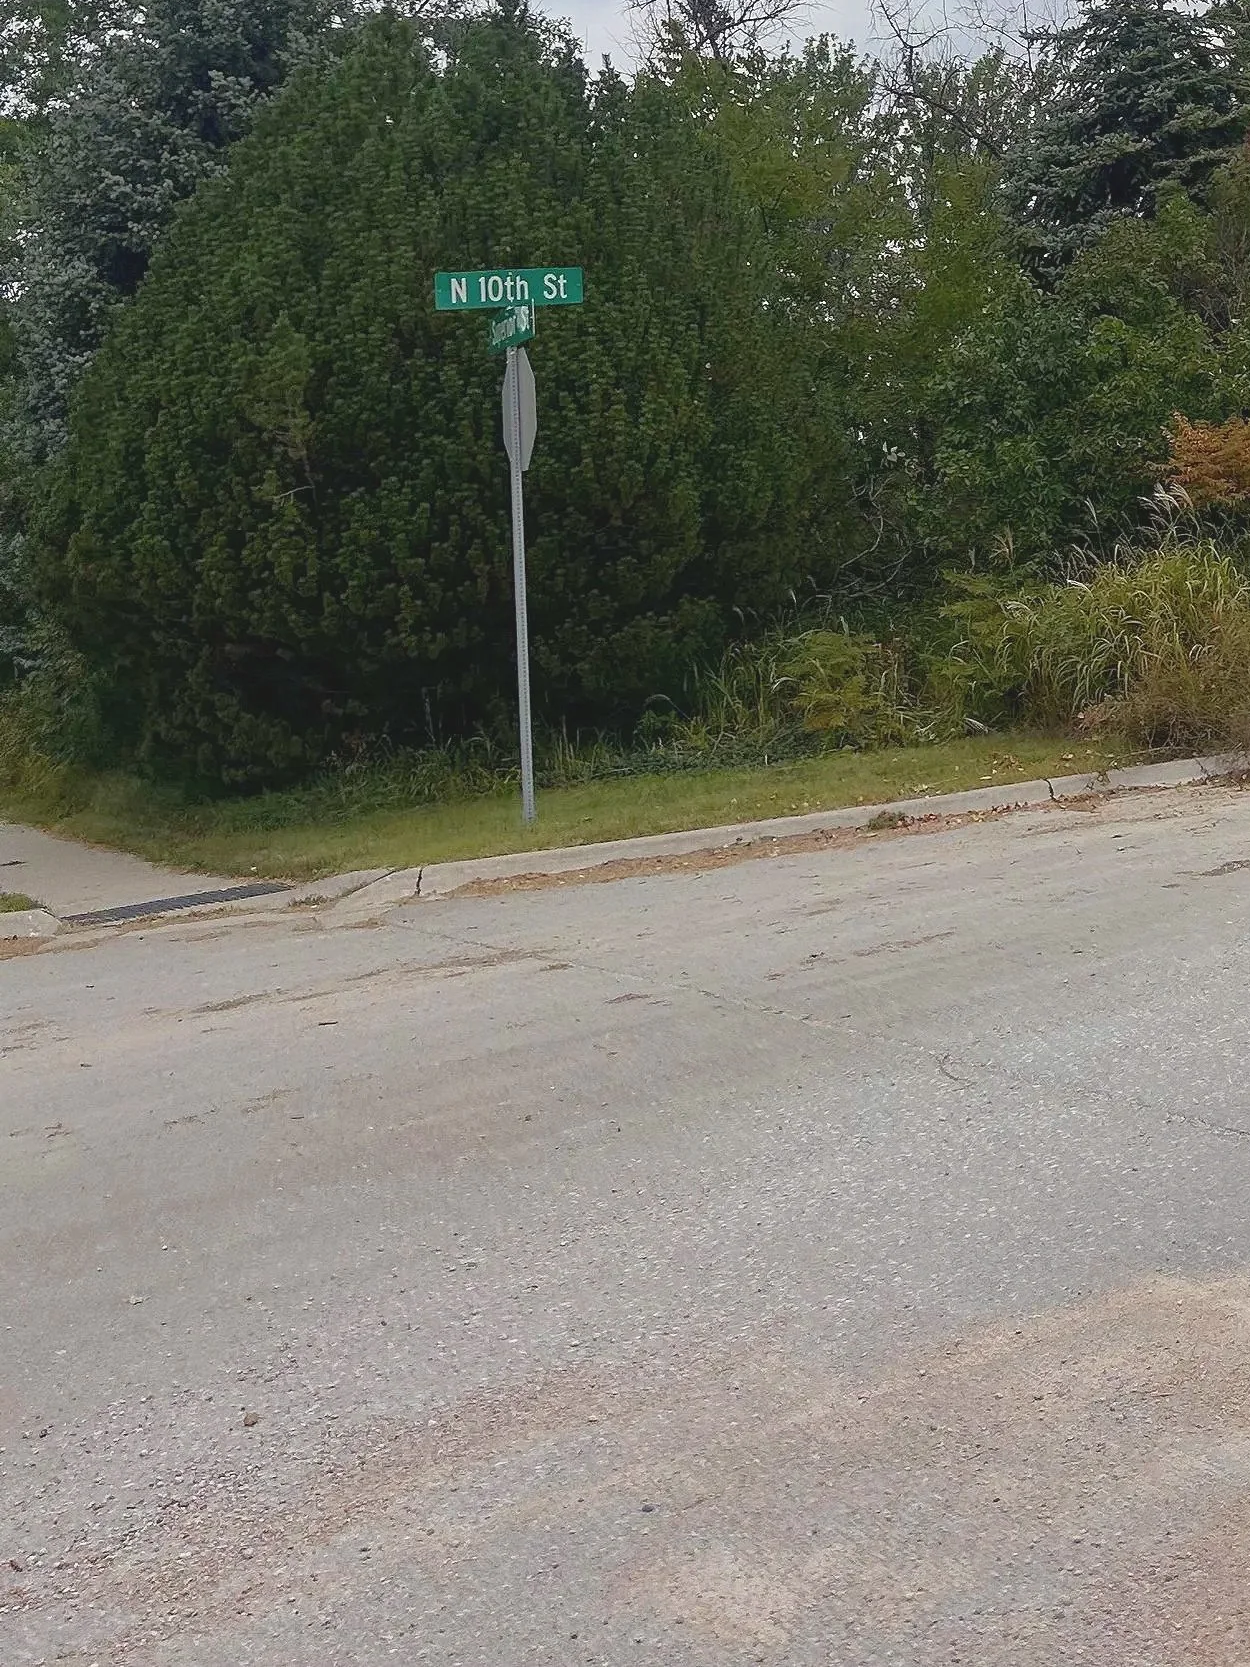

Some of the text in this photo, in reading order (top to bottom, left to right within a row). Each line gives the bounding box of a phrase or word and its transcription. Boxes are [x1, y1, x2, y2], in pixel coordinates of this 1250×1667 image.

[450, 273, 568, 304] N 10th St
